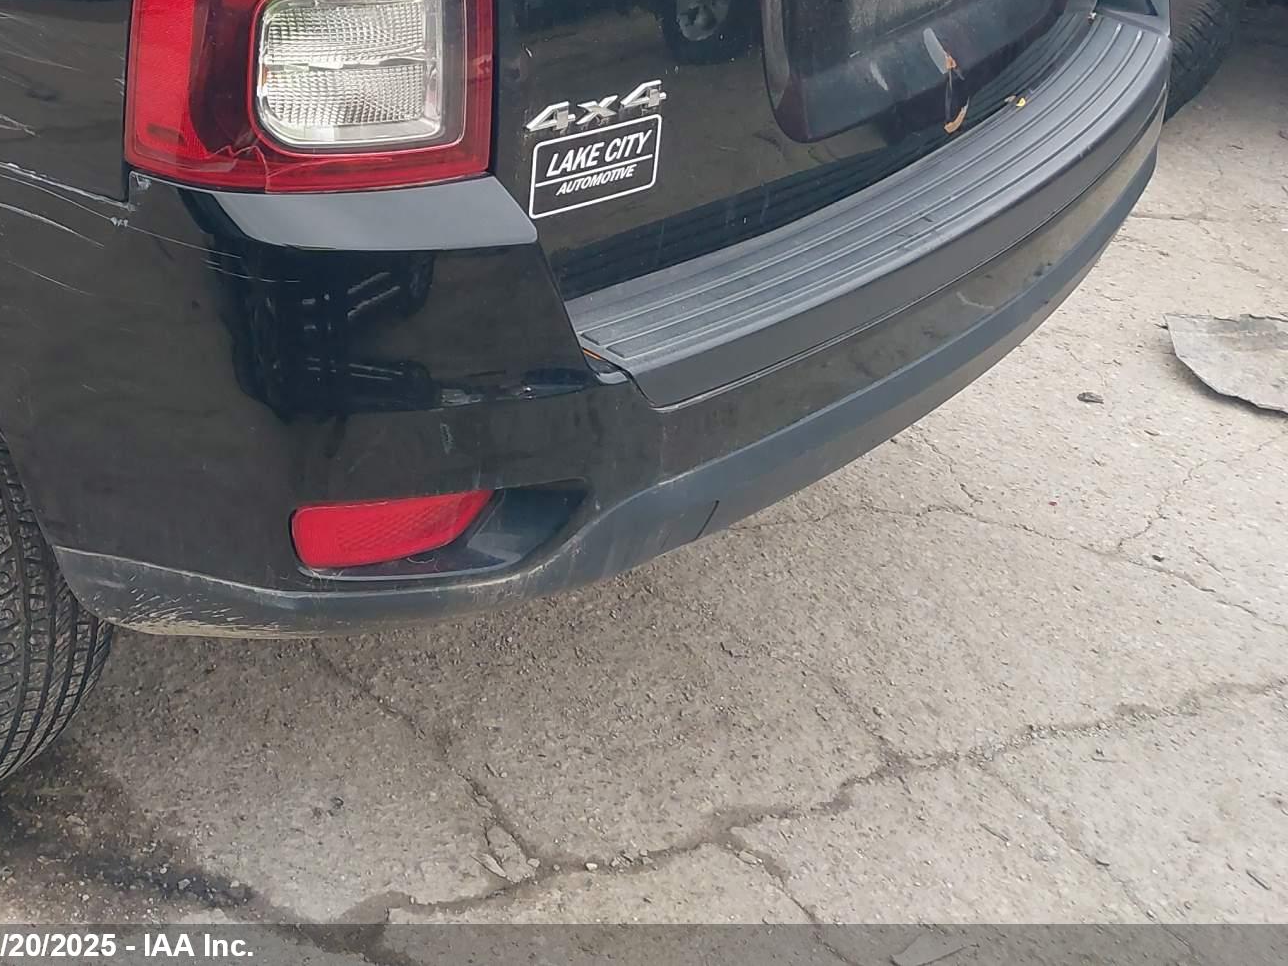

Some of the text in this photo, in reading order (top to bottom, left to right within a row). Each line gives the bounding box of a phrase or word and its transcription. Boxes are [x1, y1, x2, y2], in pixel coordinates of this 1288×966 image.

[524, 79, 667, 132] 4x4
[545, 129, 653, 178] LAKE CITY
[555, 163, 638, 197] AUTOMOTIVE
